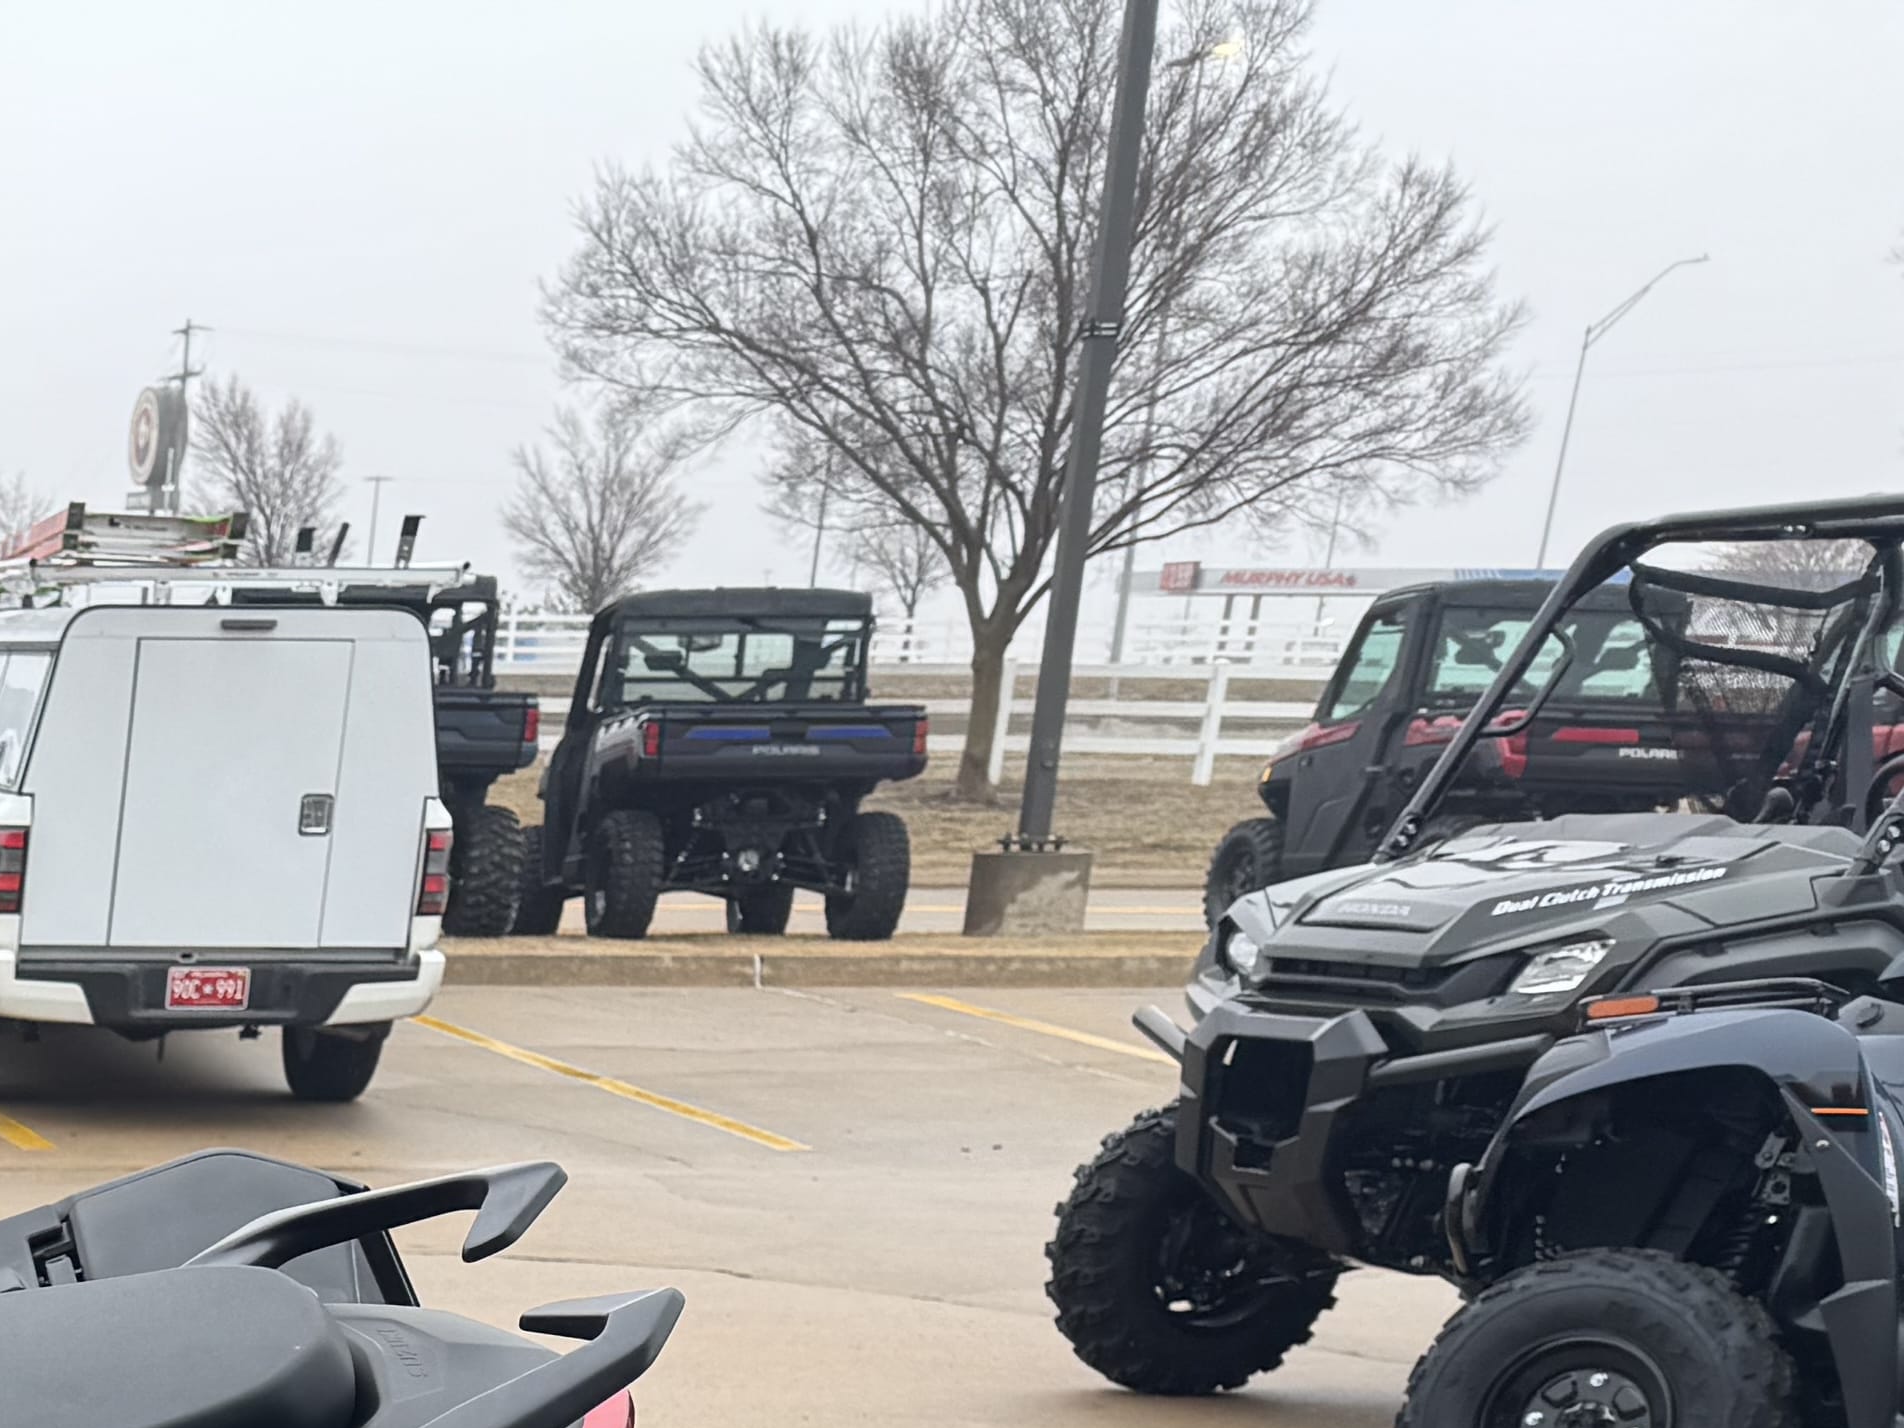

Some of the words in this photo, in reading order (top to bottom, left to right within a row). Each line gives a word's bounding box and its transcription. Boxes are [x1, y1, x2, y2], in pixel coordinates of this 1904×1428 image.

[1219, 571, 1306, 586] MURPHY
[1306, 571, 1345, 587] USA
[752, 744, 821, 755] POLARIS
[1491, 896, 1539, 916] Dual
[1538, 886, 1600, 908] Clutch
[1601, 867, 1728, 897] Transmission
